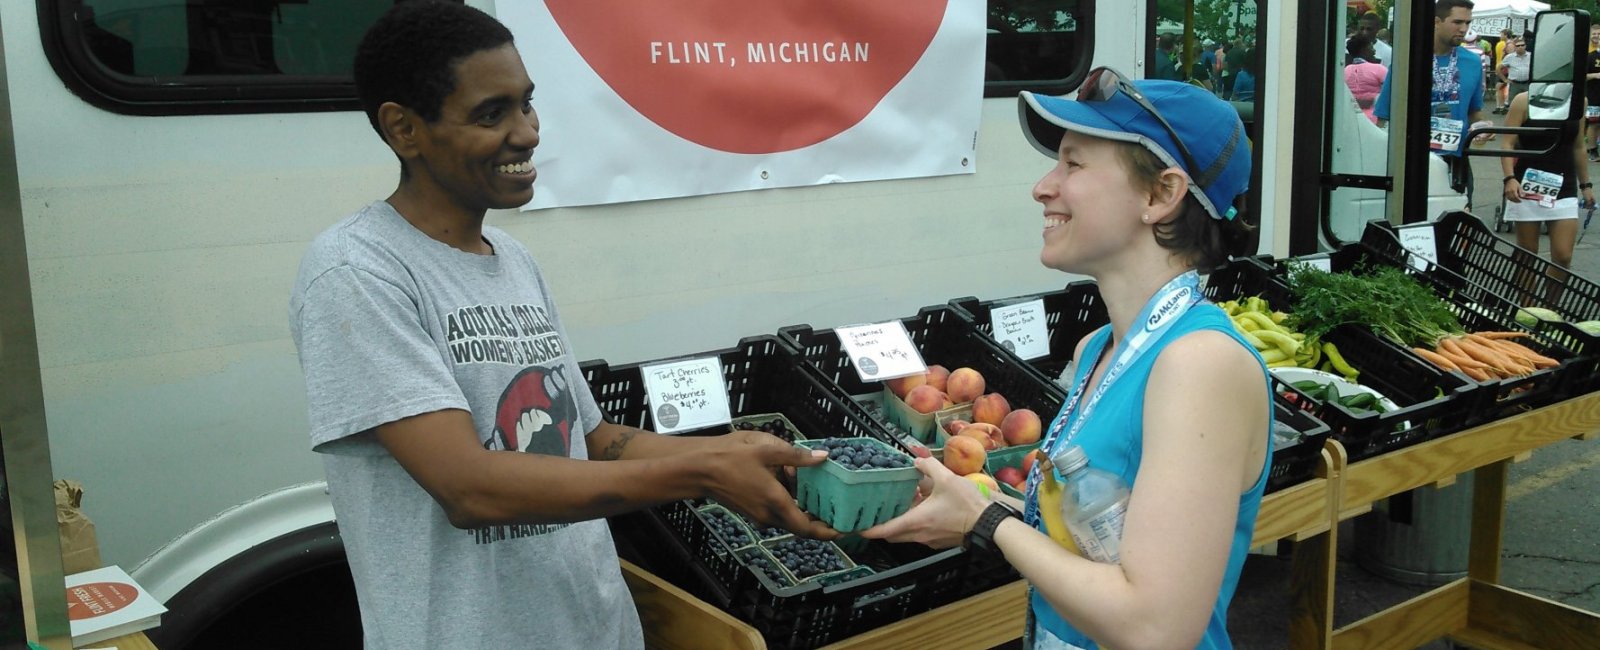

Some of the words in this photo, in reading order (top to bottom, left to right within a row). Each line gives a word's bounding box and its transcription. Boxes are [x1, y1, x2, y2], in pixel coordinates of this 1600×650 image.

[651, 42, 735, 67] FLINT,
[748, 42, 869, 63] MICHIGAN
[1429, 131, 1460, 145] 437
[1522, 182, 1558, 197] 6436
[1160, 287, 1189, 316] McLaren
[654, 368, 676, 380] Tart
[677, 366, 710, 378] Cherries
[661, 388, 706, 403] Blueberries
